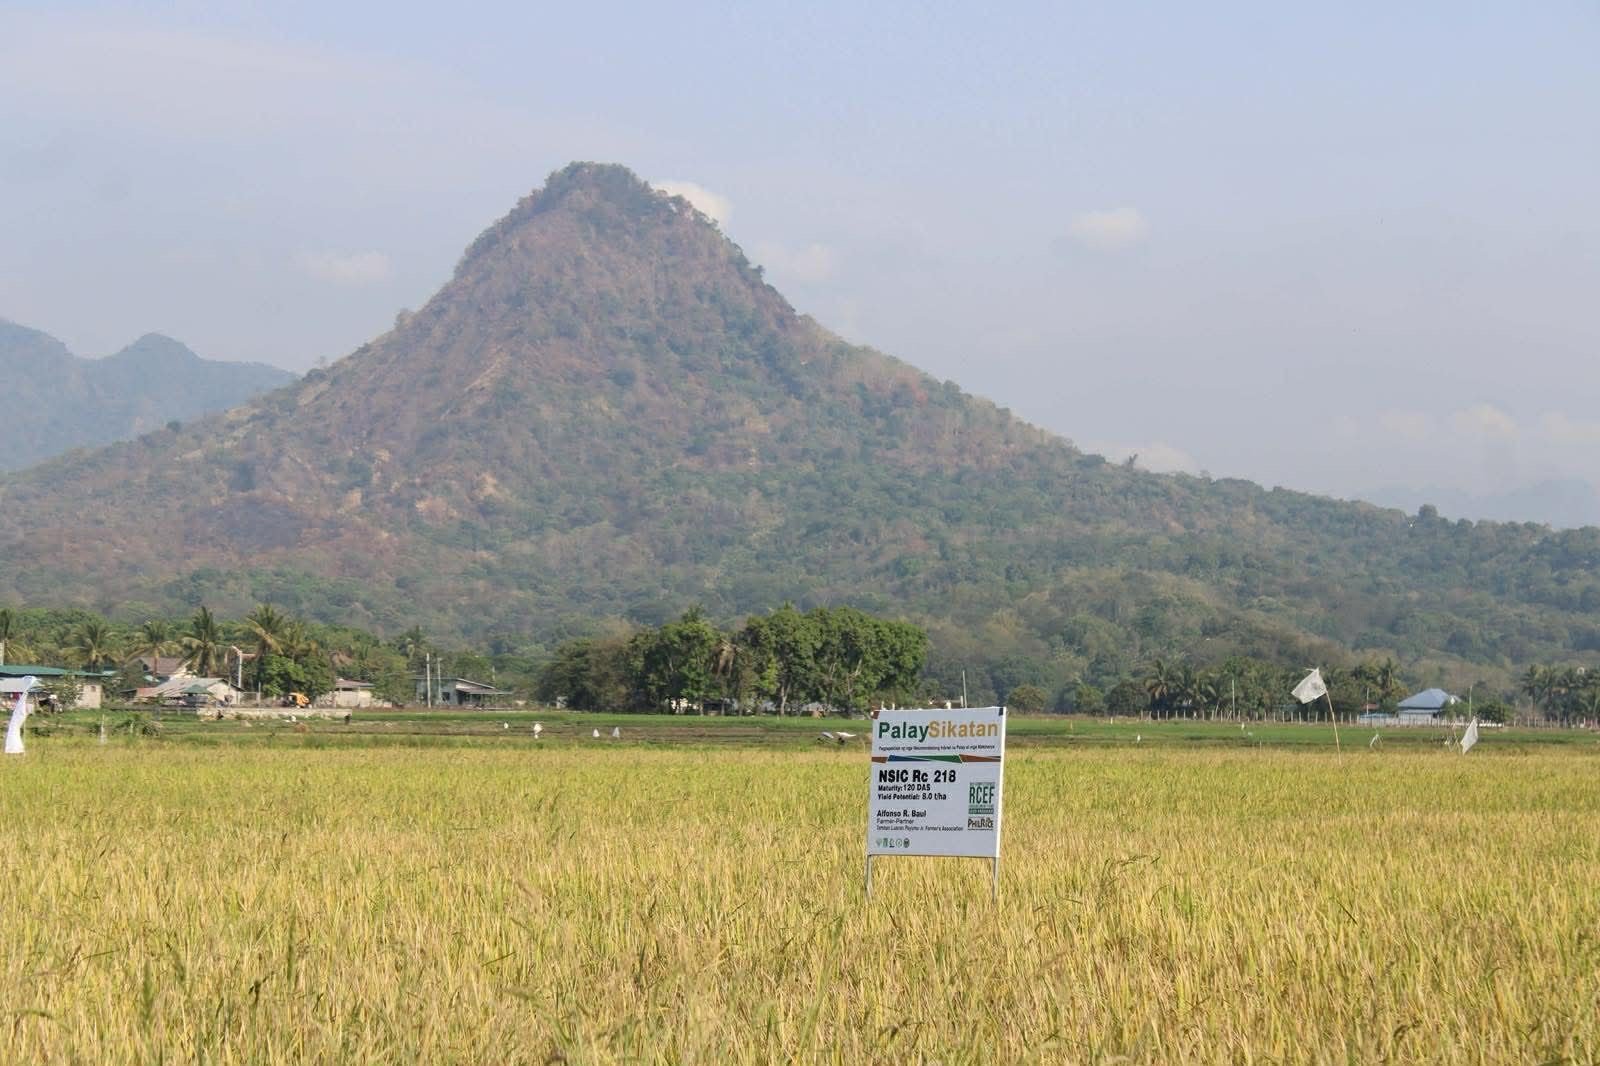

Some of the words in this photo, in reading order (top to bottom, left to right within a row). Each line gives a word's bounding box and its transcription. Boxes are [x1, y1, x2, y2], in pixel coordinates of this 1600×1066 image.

[879, 721, 998, 743] PalaySikatan
[879, 770, 909, 783] NSIC
[912, 770, 929, 783] Rc
[934, 770, 957, 783] 218
[878, 785, 903, 793] Maturity:
[903, 784, 915, 792] 120
[917, 783, 931, 791] DAS
[892, 793, 920, 801] Potential:
[969, 786, 995, 804] RCEF
[876, 809, 901, 818] Alfonso
[902, 809, 910, 817] R.
[911, 809, 927, 818] Baul
